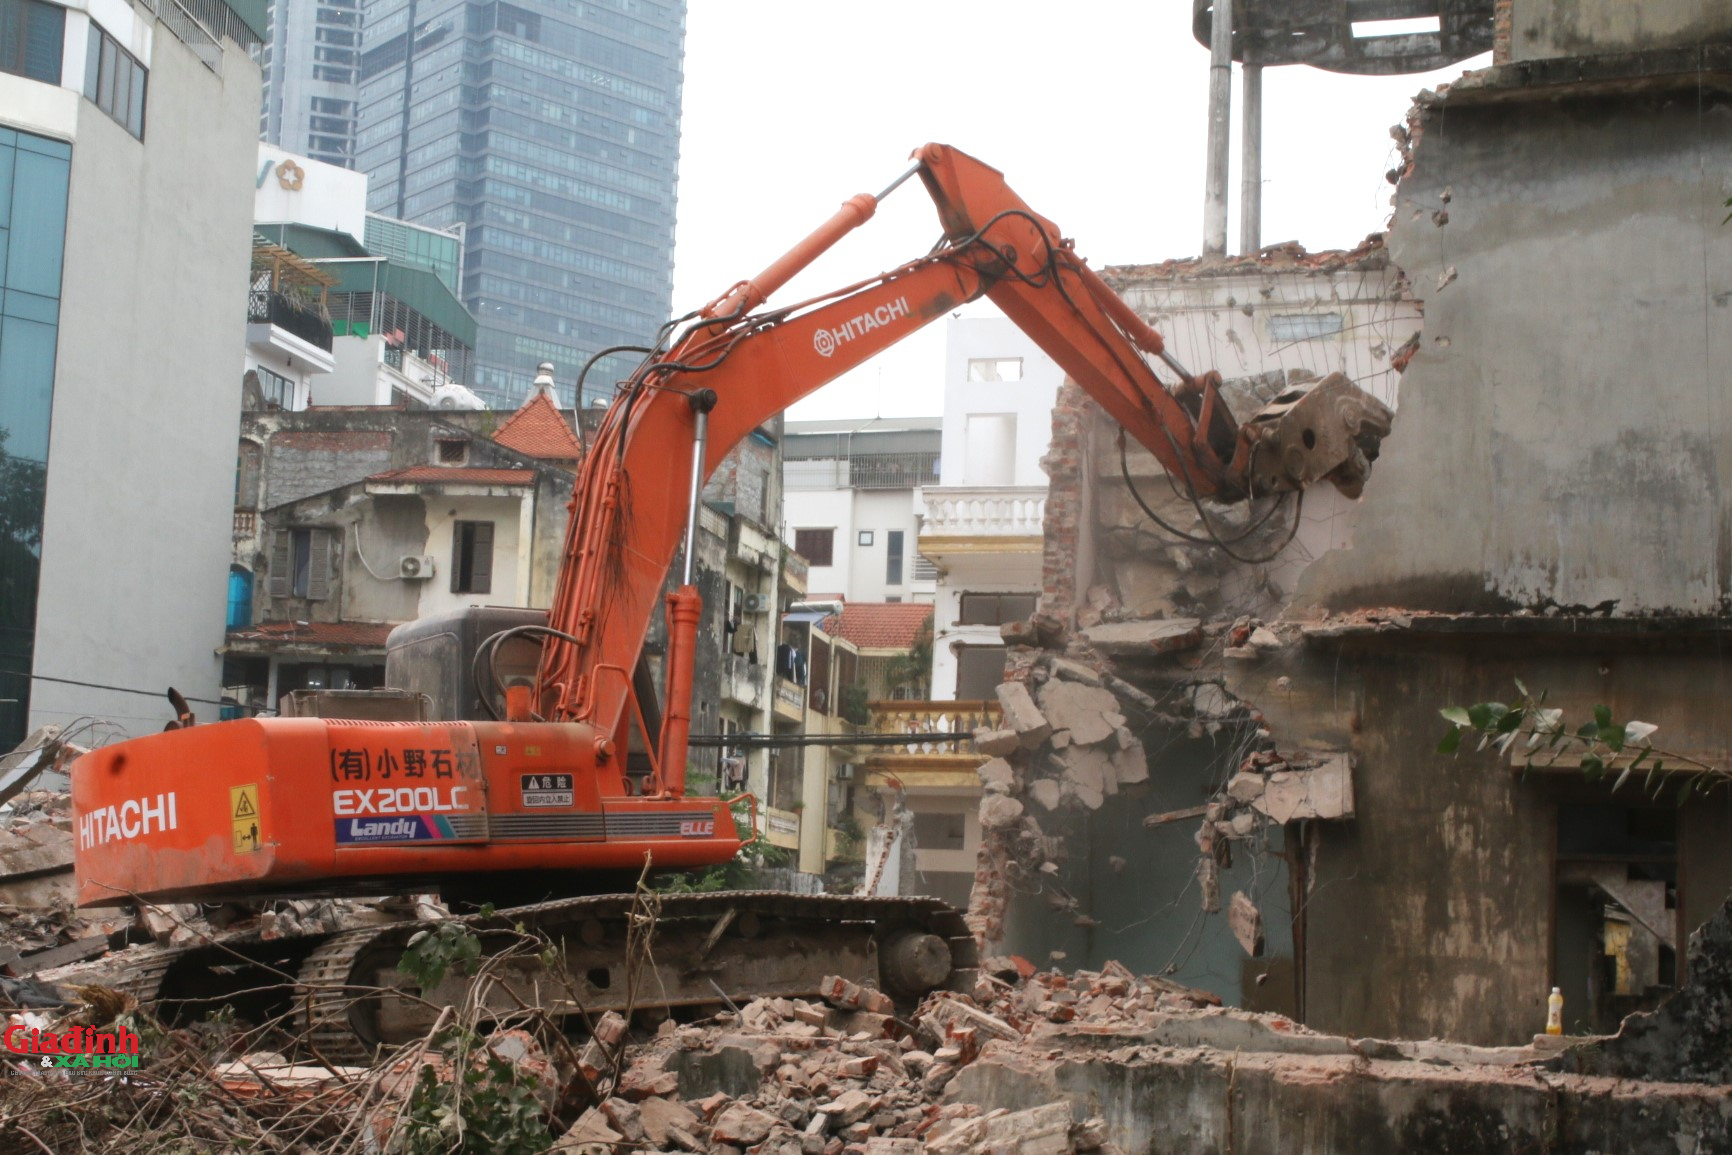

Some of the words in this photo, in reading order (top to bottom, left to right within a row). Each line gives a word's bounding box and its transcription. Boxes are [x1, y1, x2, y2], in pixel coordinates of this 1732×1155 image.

[832, 296, 910, 346] HITACHI
[333, 786, 469, 815] EX200LC
[80, 792, 177, 851] HITACHI
[350, 818, 417, 839] Landy
